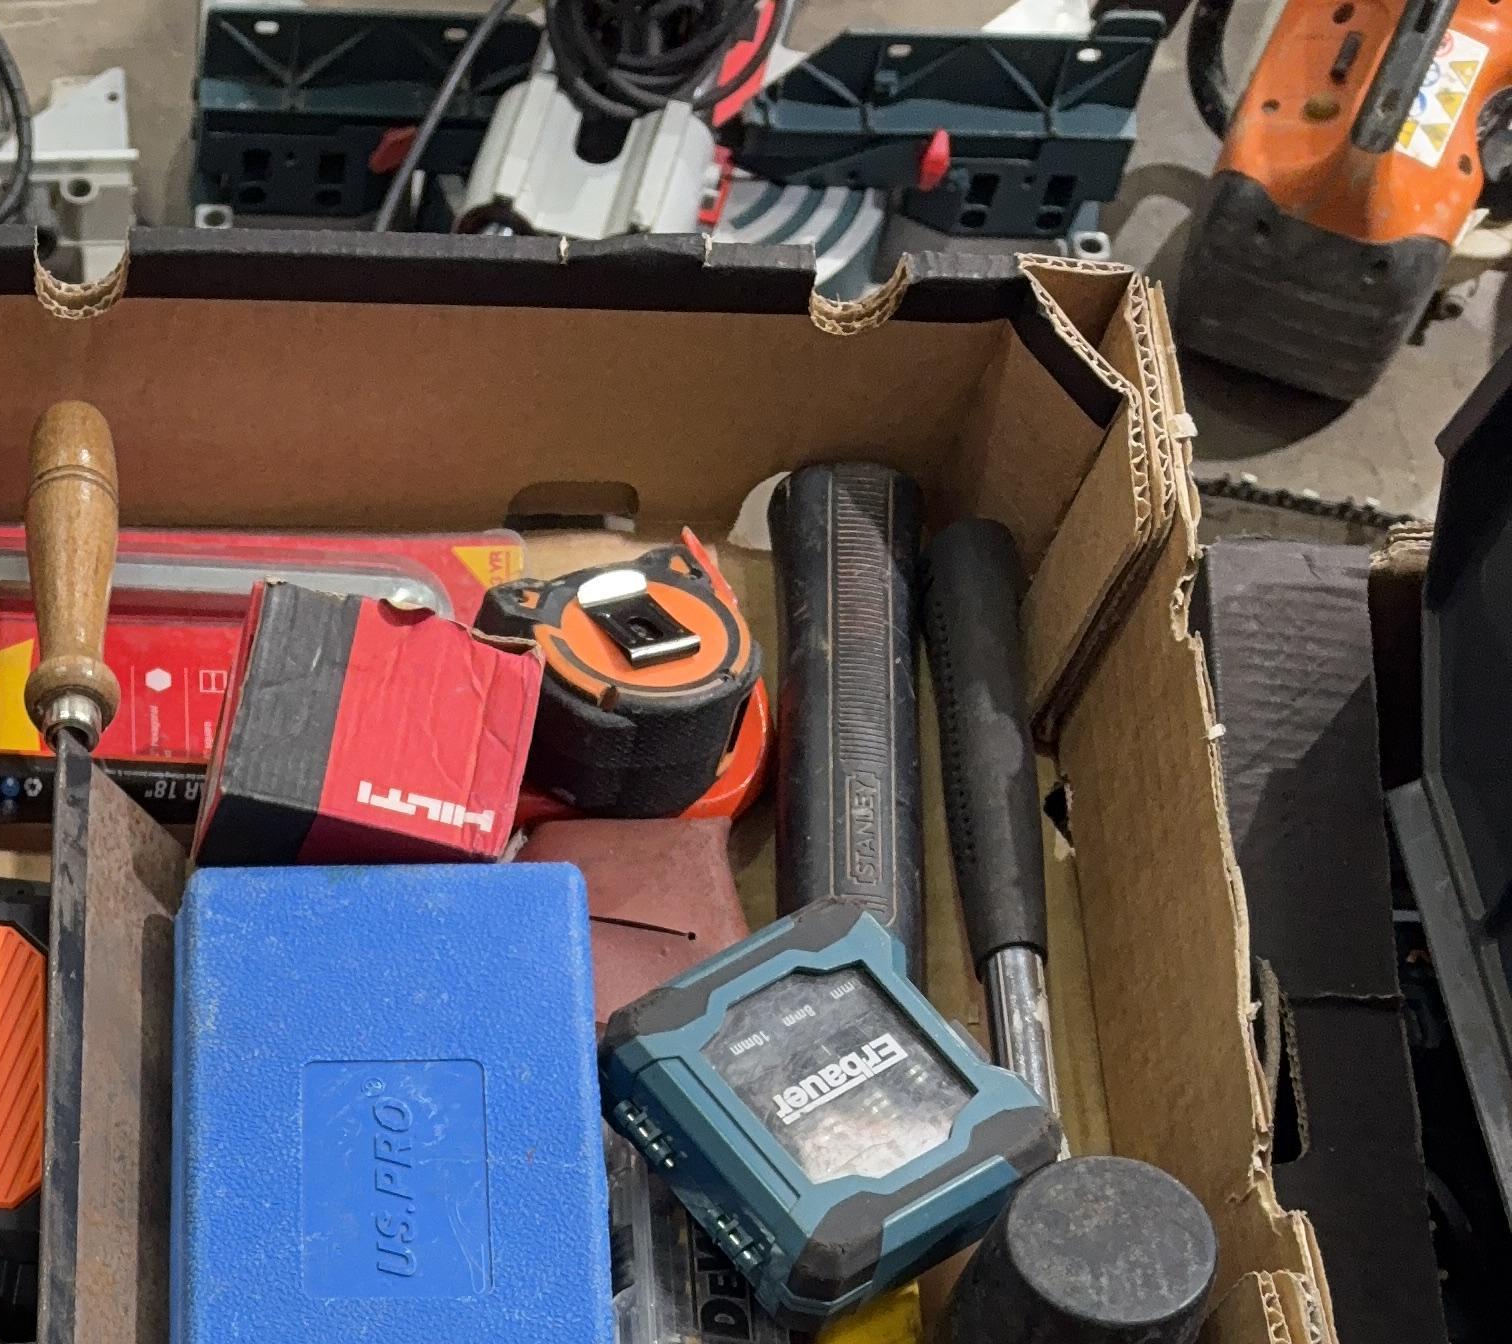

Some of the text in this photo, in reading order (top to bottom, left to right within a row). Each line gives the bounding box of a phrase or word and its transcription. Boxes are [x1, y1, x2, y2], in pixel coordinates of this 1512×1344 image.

[357, 780, 494, 834] HILTI
[854, 771, 884, 879] STANLEY
[728, 1028, 772, 1058] 10mm
[774, 1032, 907, 1126] Erbauer
